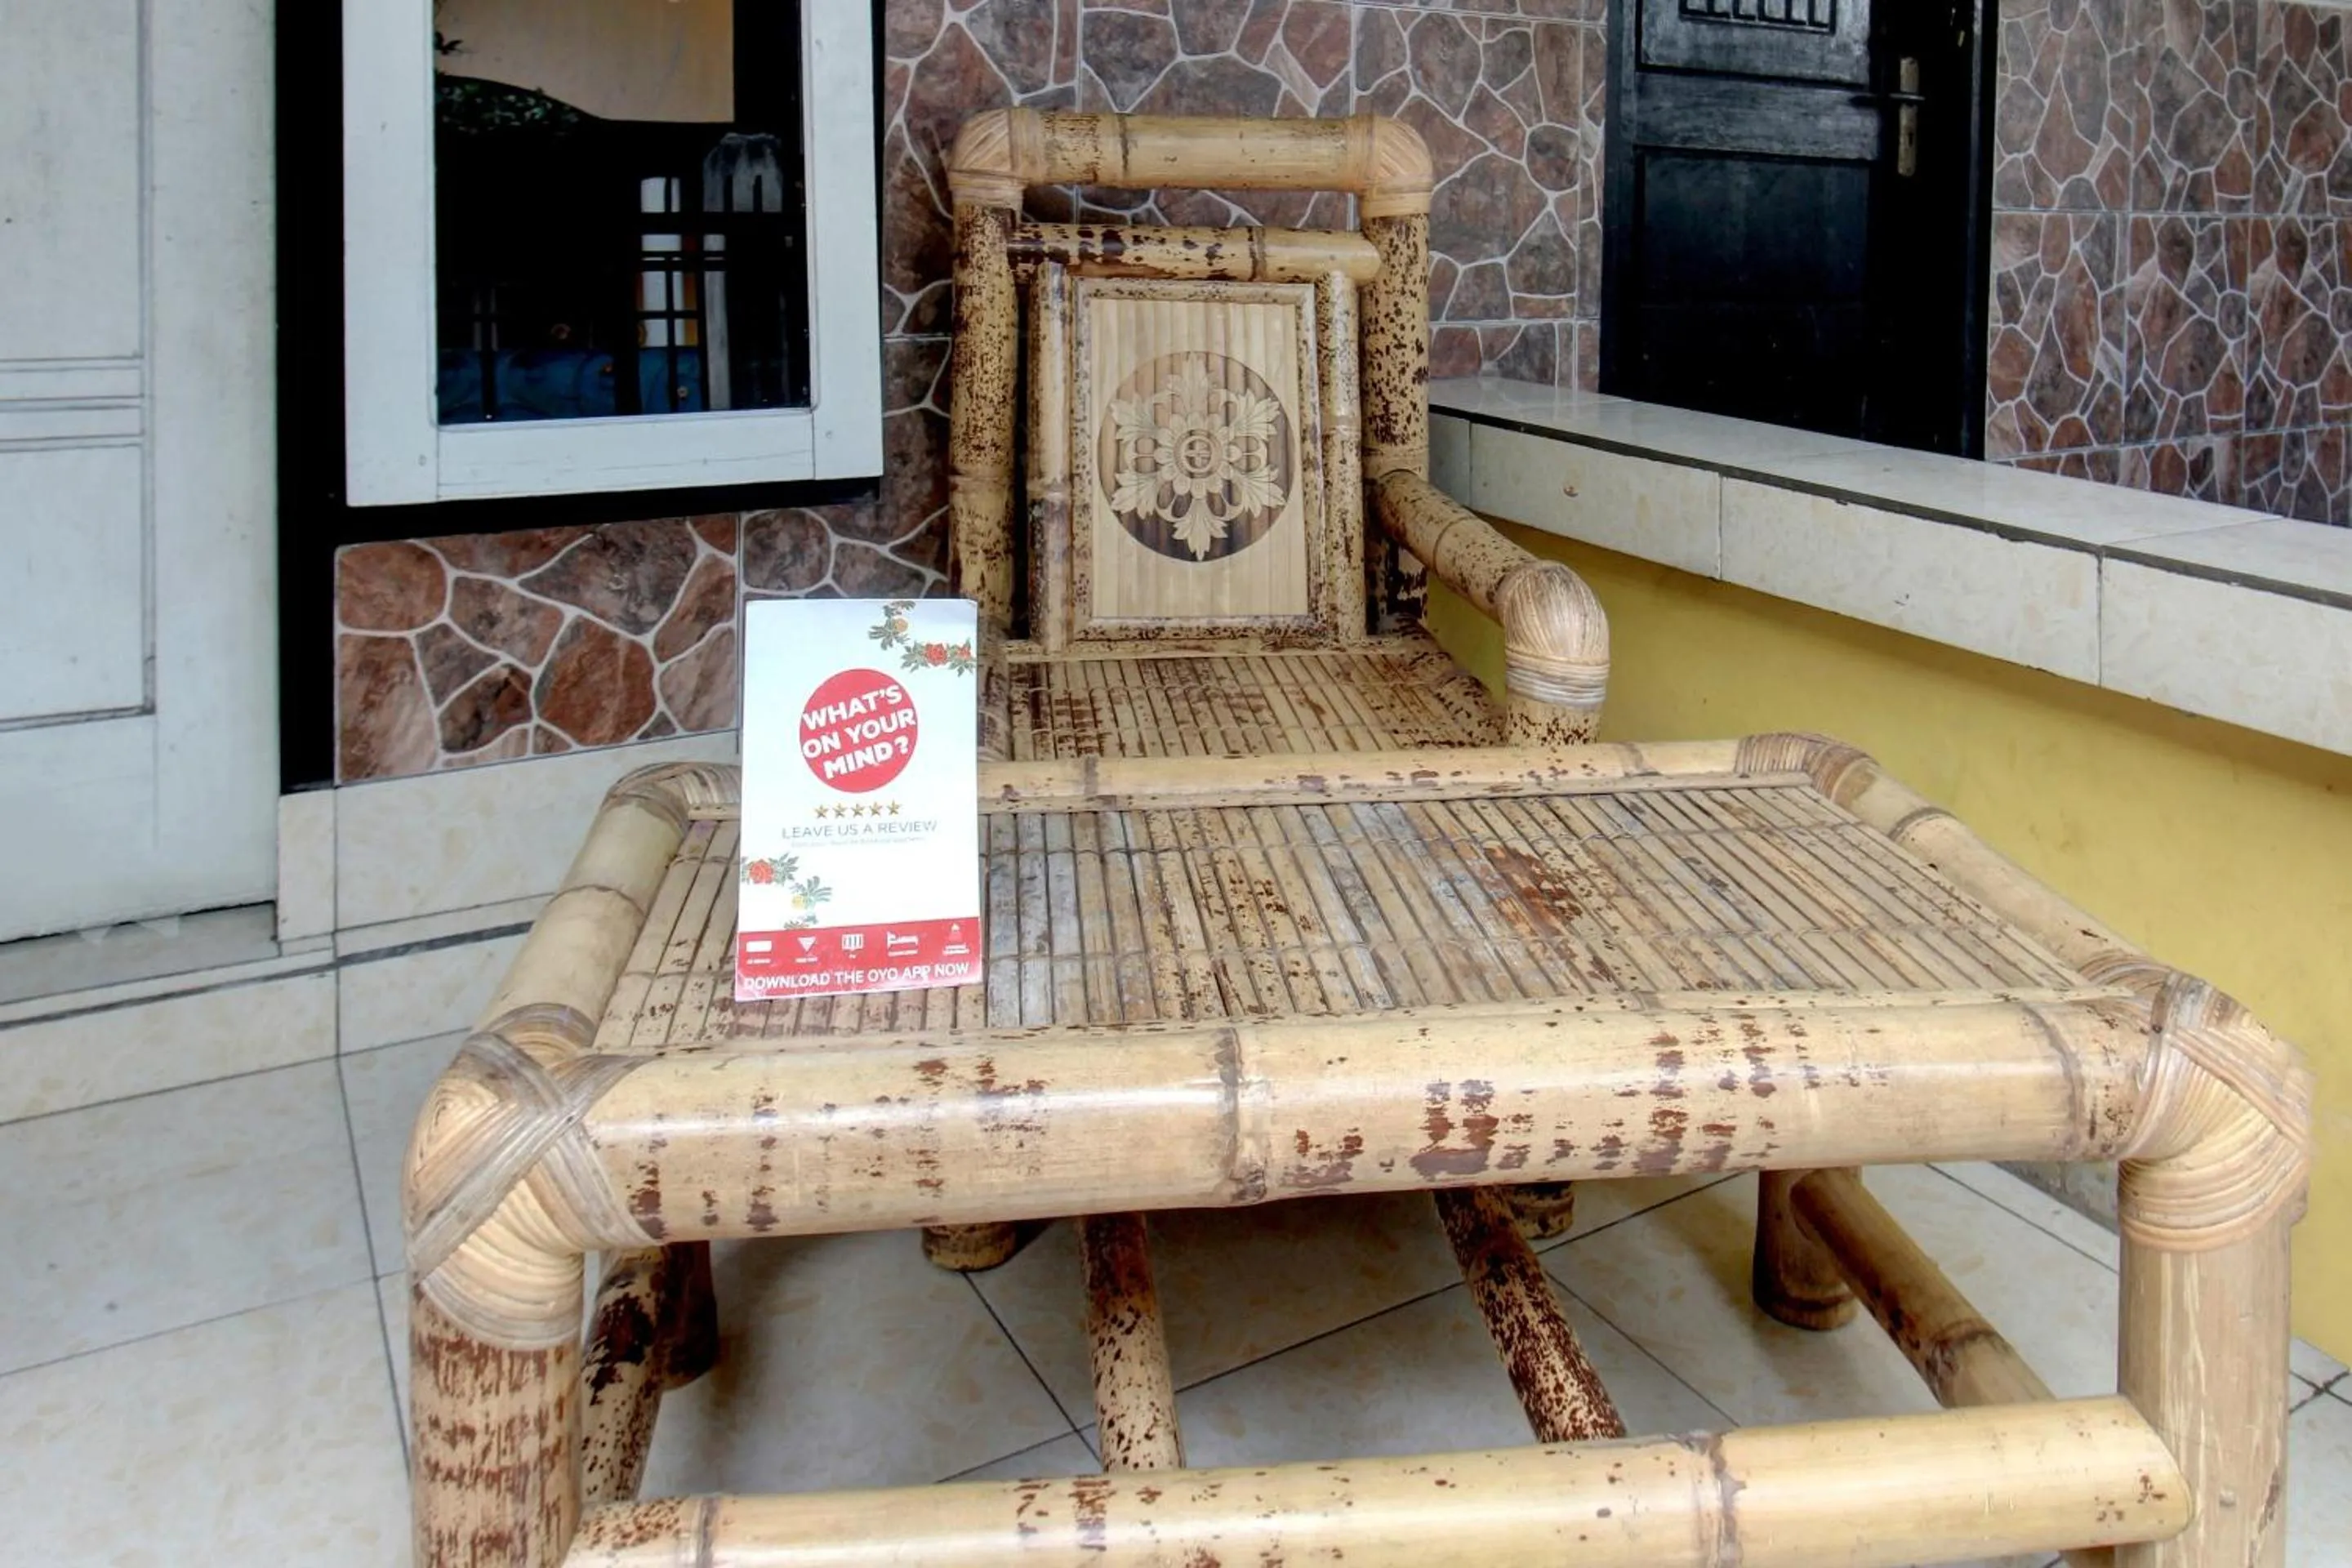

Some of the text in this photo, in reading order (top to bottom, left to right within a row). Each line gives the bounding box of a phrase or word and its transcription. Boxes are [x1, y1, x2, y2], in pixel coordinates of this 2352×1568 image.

[803, 684, 902, 730] WHAT'S
[802, 708, 915, 758] ON YOUR
[782, 820, 938, 840] LEAVE US A REVIEW
[743, 961, 969, 991] DOWNLOAD THE OYO APP NOW
